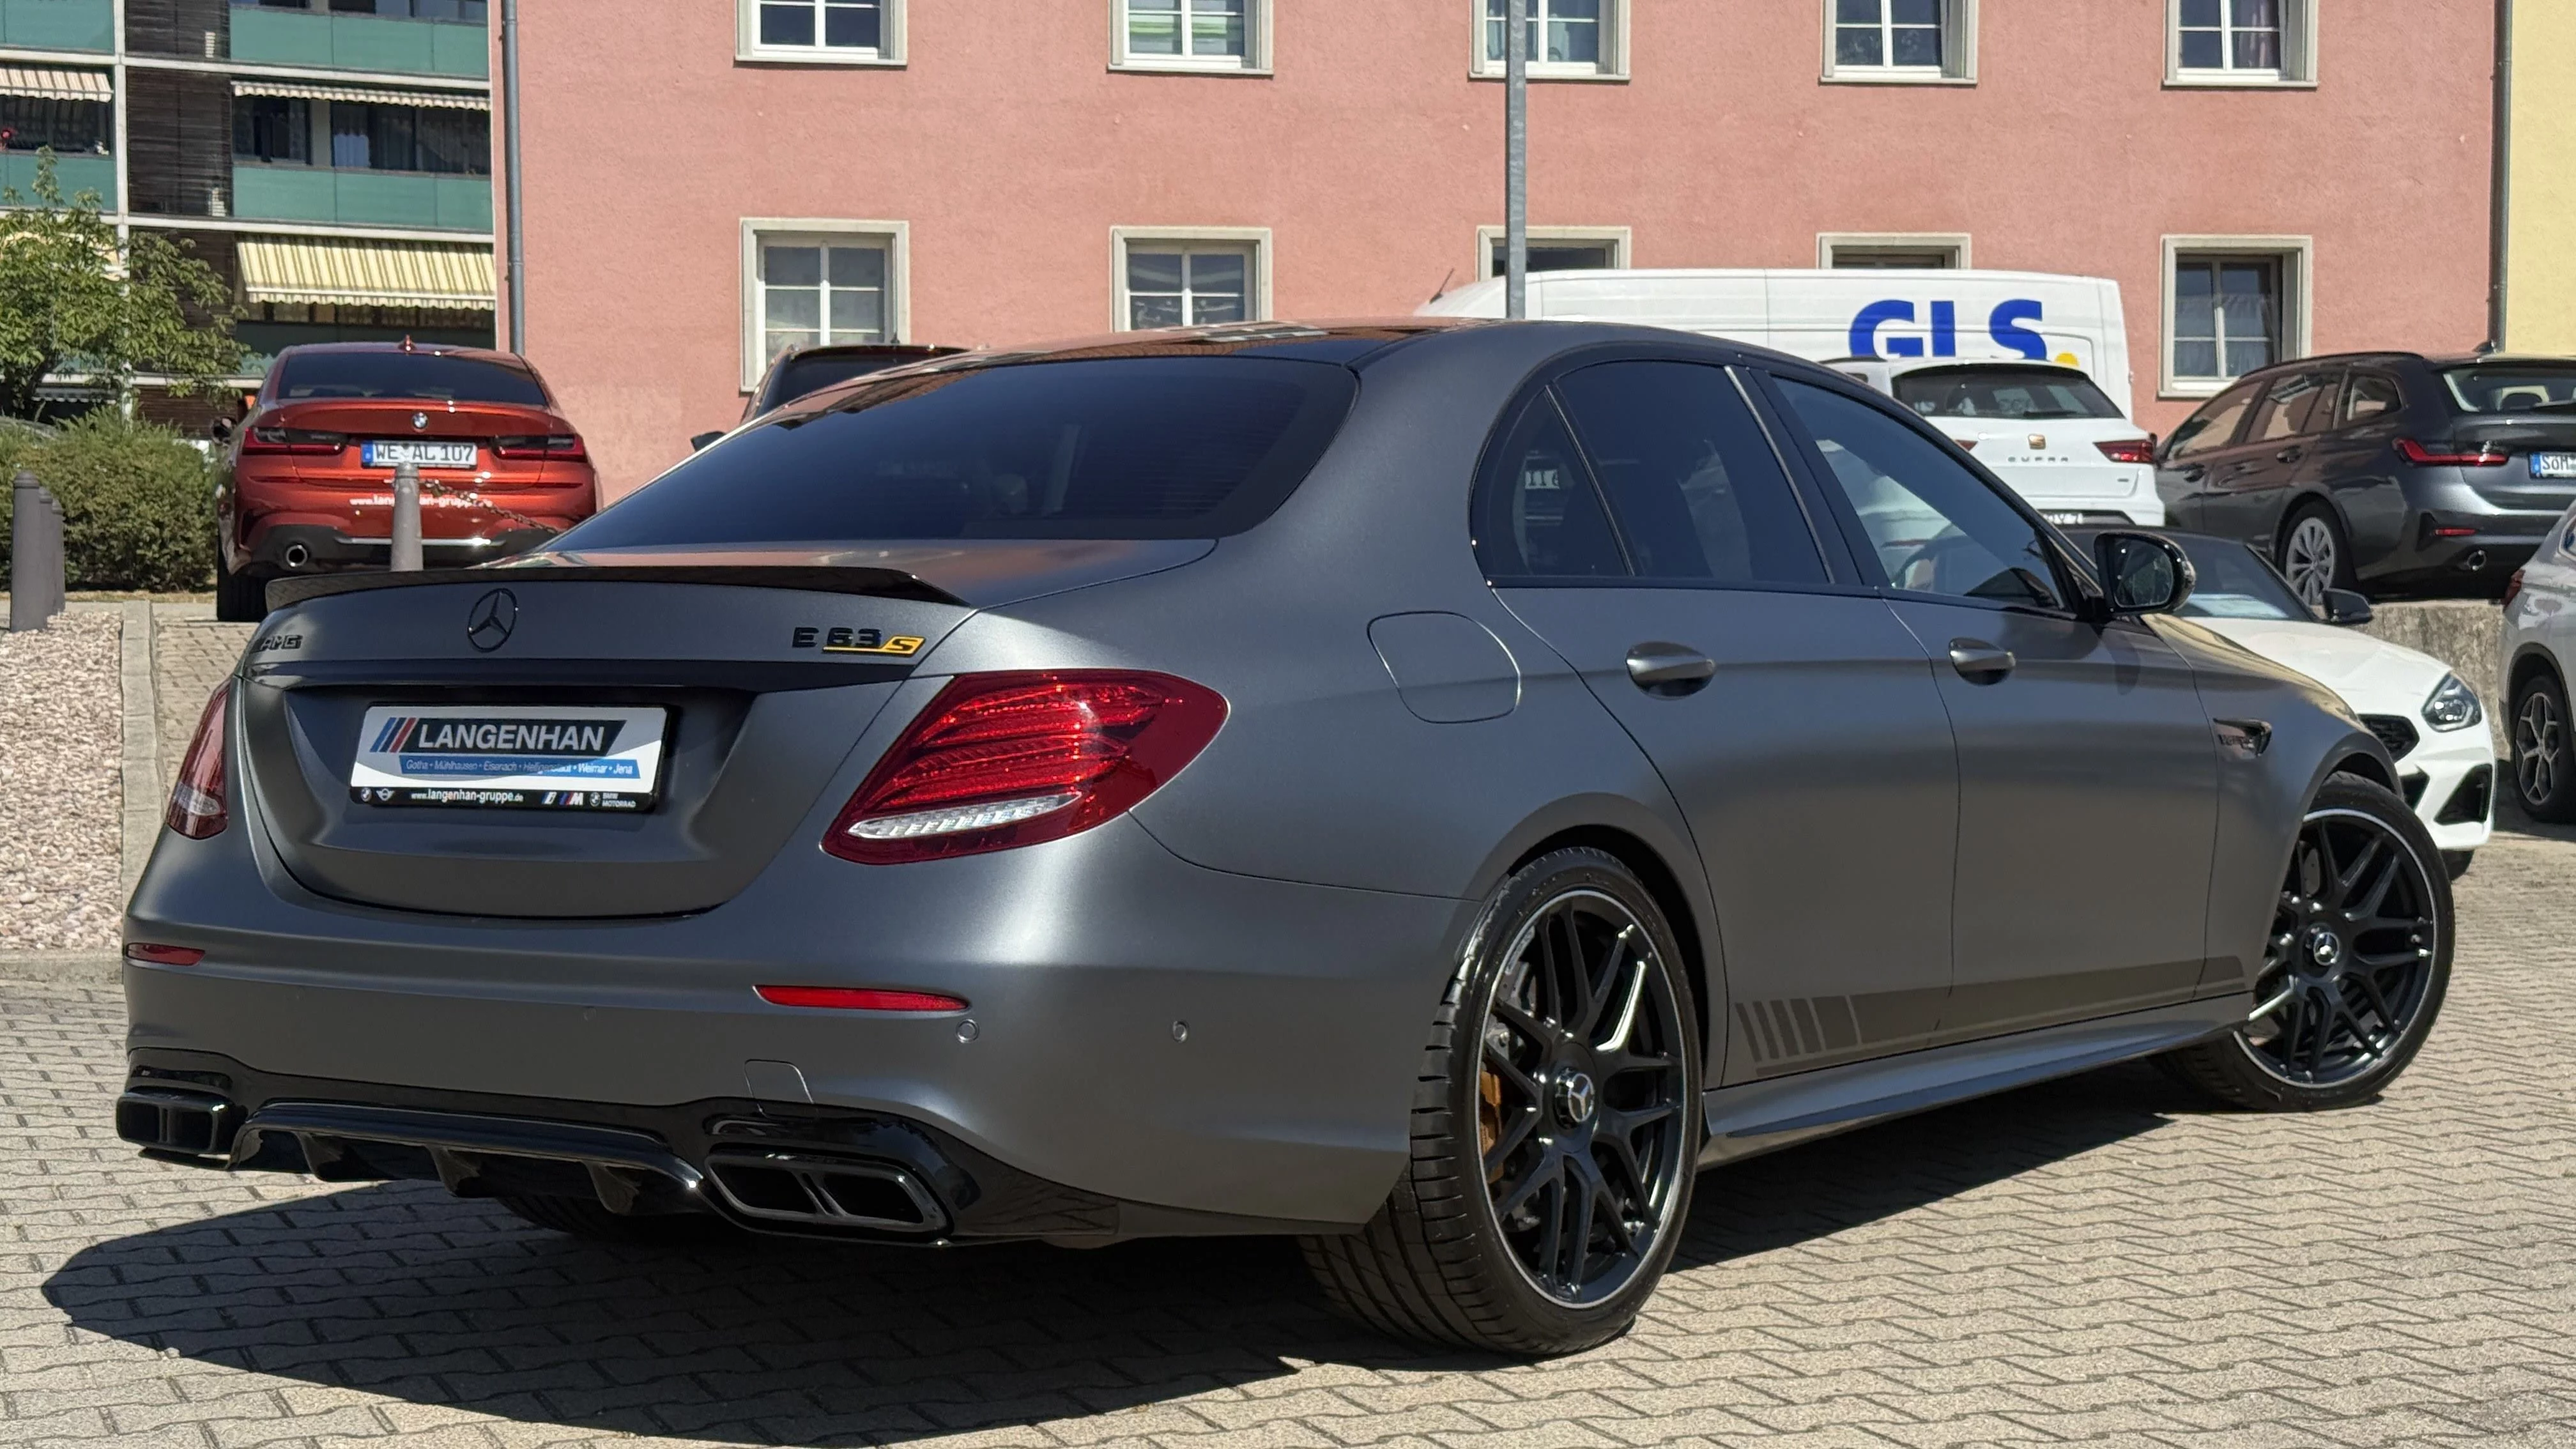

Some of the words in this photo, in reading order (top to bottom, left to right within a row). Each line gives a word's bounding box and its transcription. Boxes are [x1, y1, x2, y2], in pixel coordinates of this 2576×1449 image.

[374, 443, 399, 460] WE
[412, 445, 436, 460] AL
[440, 447, 473, 461] 107
[259, 634, 303, 650] AMG
[792, 627, 819, 648] E
[827, 627, 882, 648] 63
[418, 724, 605, 751] LANGENHAN
[406, 759, 429, 770] Gotha
[578, 763, 607, 774] Weimar
[613, 763, 632, 774] Jena
[411, 788, 524, 803] www.langenhan-gruppe.de
